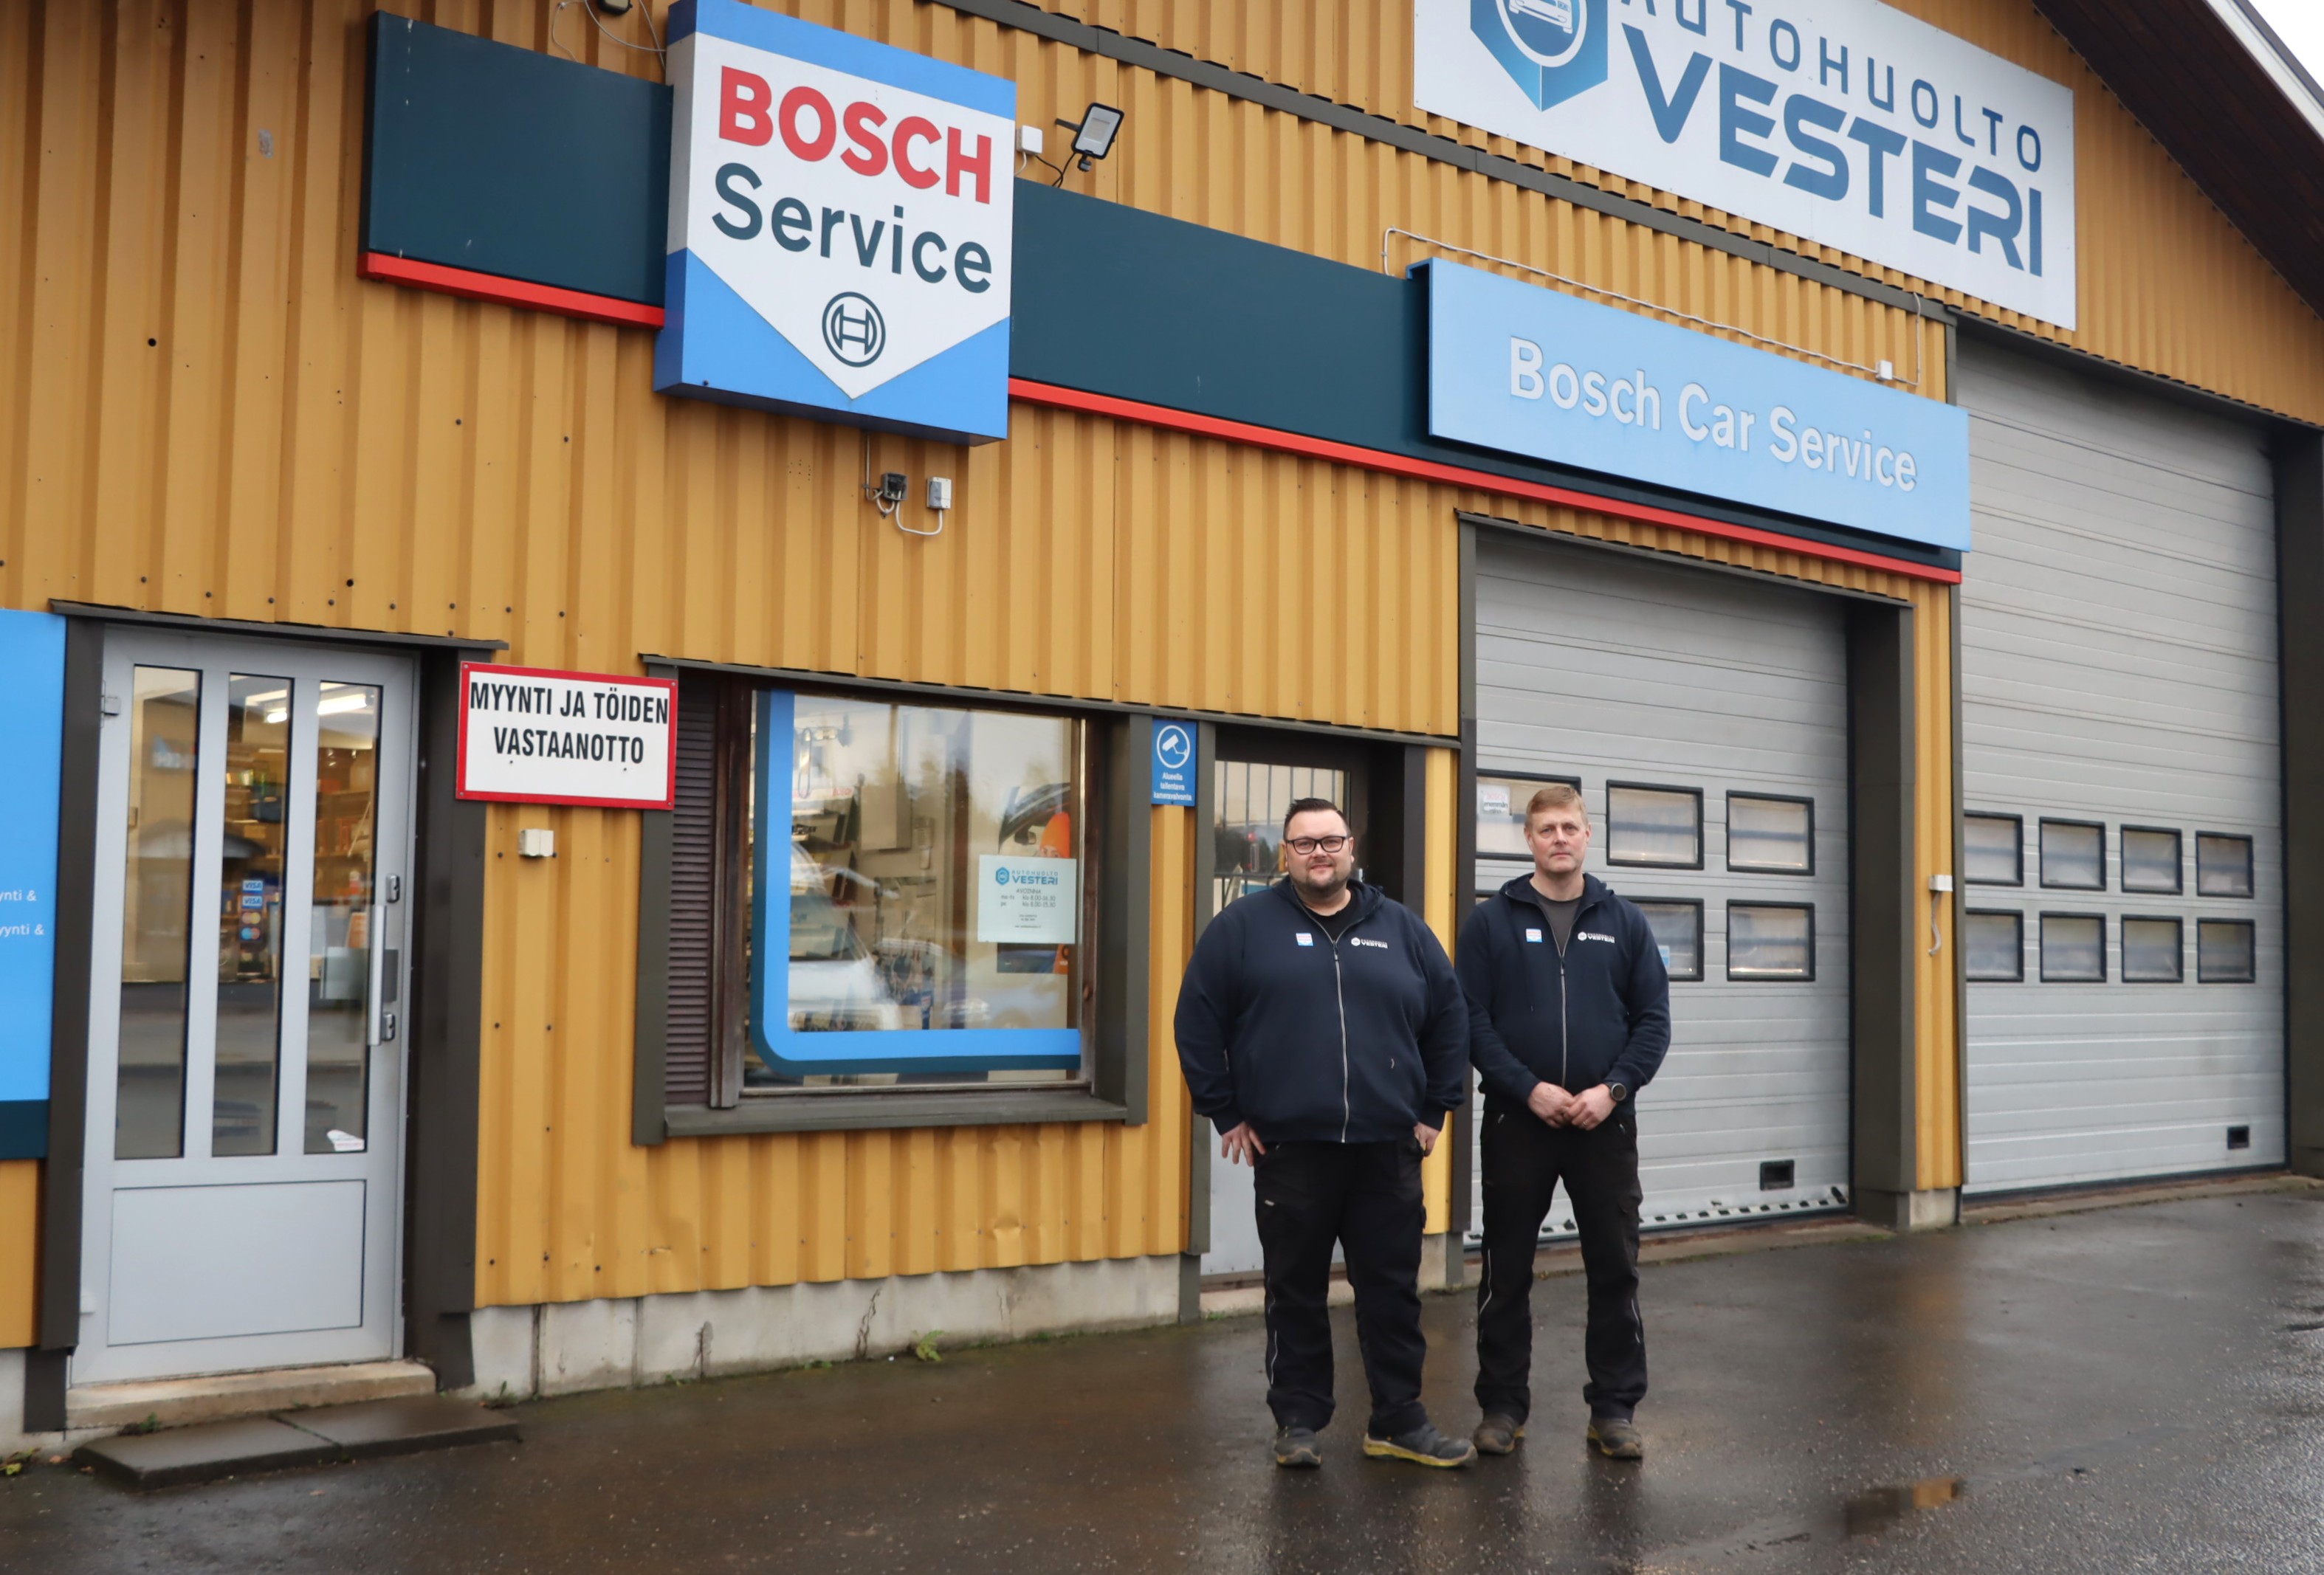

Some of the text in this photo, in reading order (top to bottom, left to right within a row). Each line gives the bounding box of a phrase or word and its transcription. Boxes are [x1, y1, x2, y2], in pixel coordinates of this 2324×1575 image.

[1621, 0, 2041, 173] UTOHUOLTO
[719, 65, 991, 204] BOSCH
[1620, 22, 2043, 277] VESTERI
[712, 162, 991, 293] Service
[1510, 335, 1918, 492] Bosch Car Service
[470, 681, 668, 724] MYYNTI JA TÖIDEN
[493, 726, 644, 764] VASTAANOTTO
[27, 889, 37, 901] &
[244, 881, 262, 889] VISA
[244, 896, 262, 905] VISA
[1012, 875, 1058, 886] VESTERI
[35, 923, 44, 935] &
